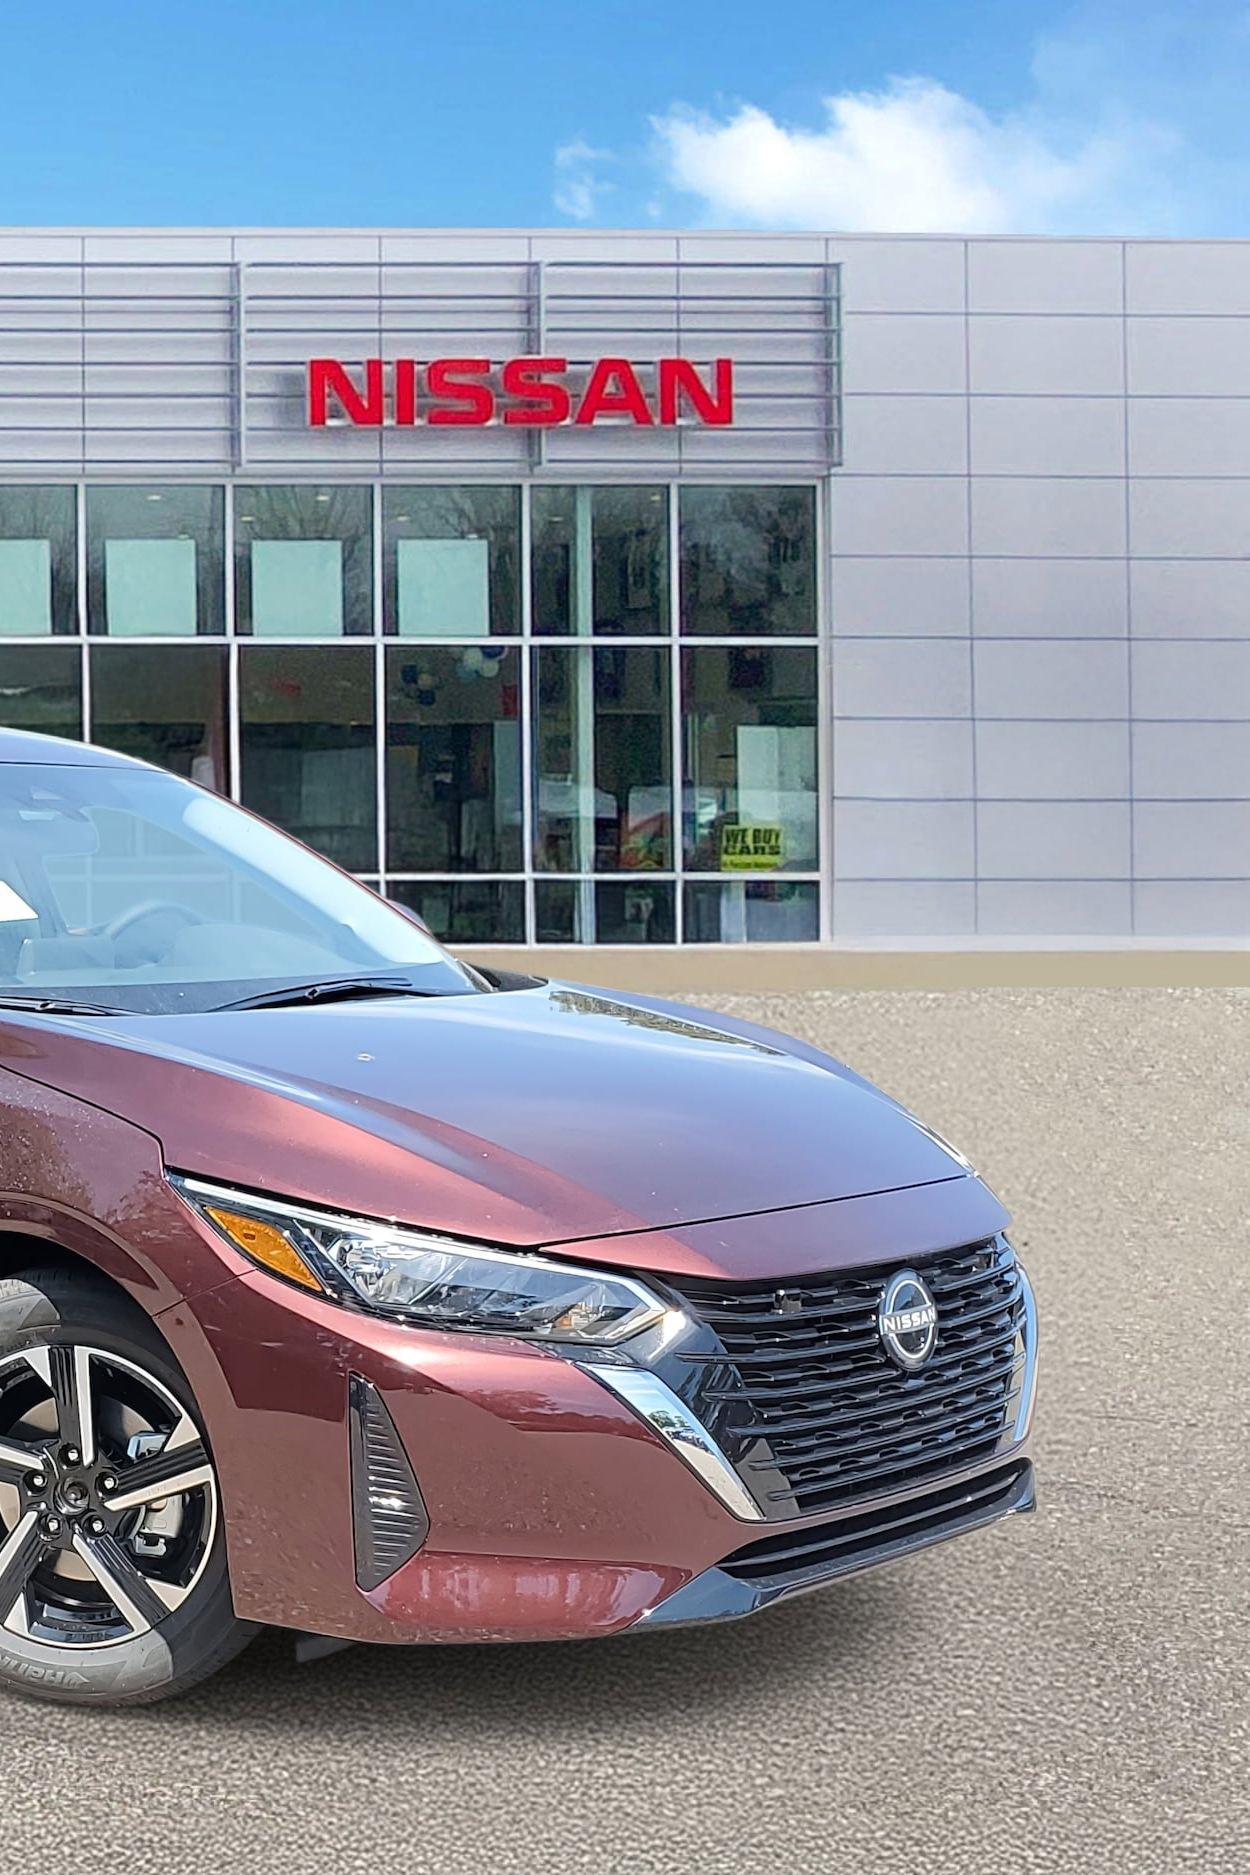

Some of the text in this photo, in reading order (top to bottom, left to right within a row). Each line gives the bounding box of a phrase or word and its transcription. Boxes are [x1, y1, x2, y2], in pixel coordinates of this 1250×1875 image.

[309, 357, 734, 426] NISSAN
[725, 828, 781, 845] WE BUY
[723, 845, 781, 856] CARS
[883, 1306, 936, 1332] NISSAN
